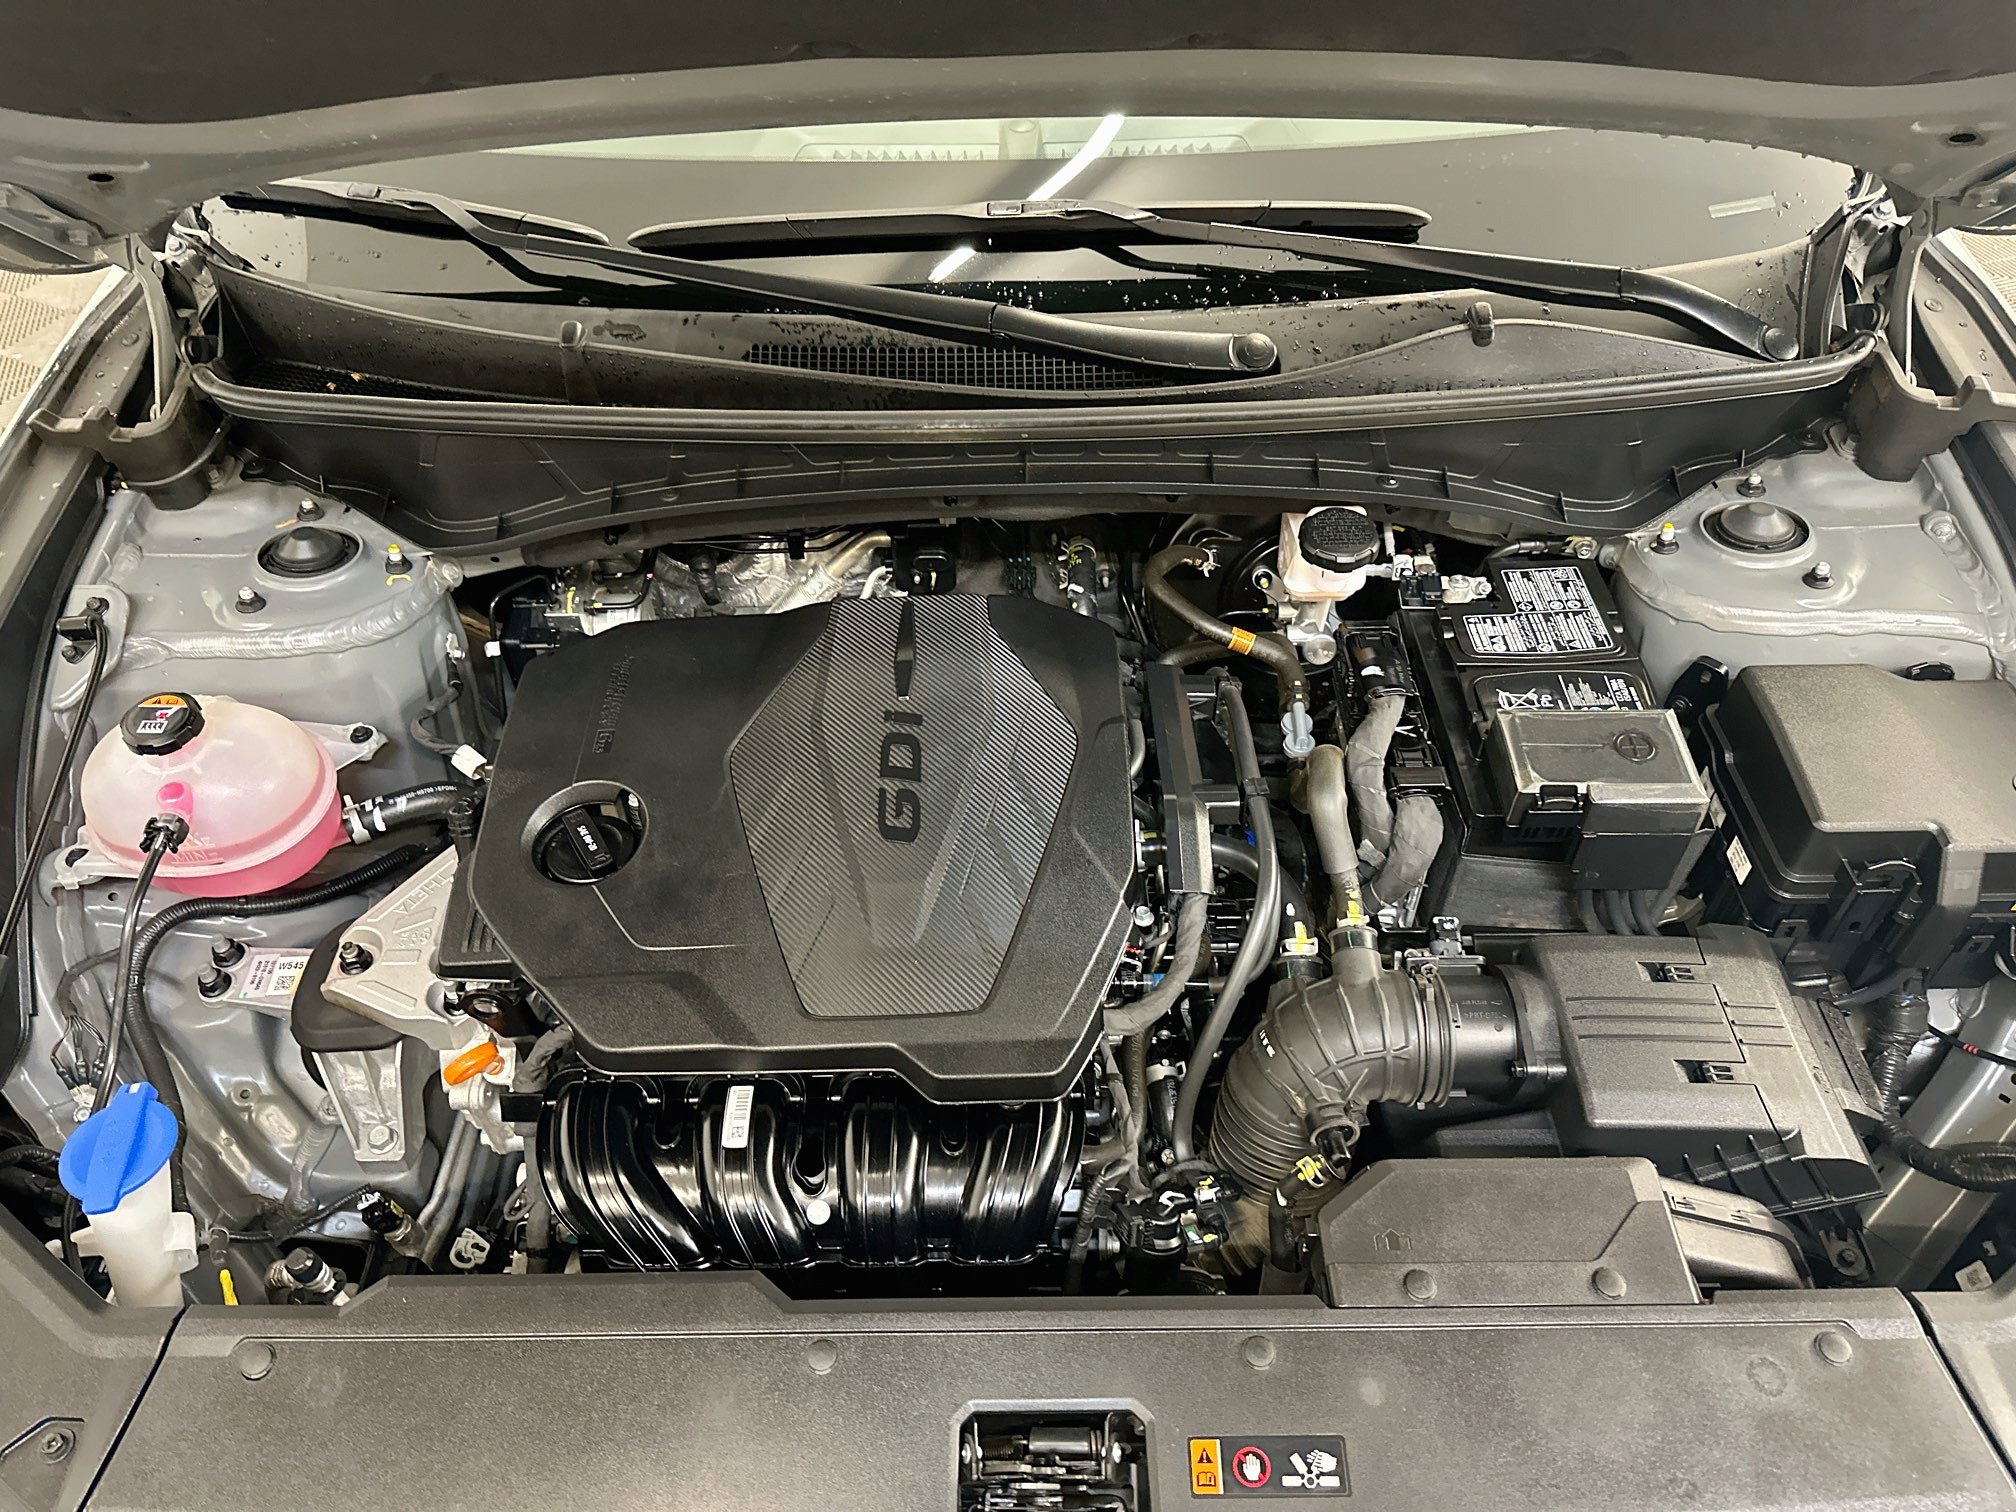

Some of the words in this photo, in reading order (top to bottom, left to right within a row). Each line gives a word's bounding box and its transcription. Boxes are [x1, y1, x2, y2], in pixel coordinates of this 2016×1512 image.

[1540, 694, 1554, 707] Pb
[393, 874, 447, 913] THETA
[279, 962, 304, 970] W545
